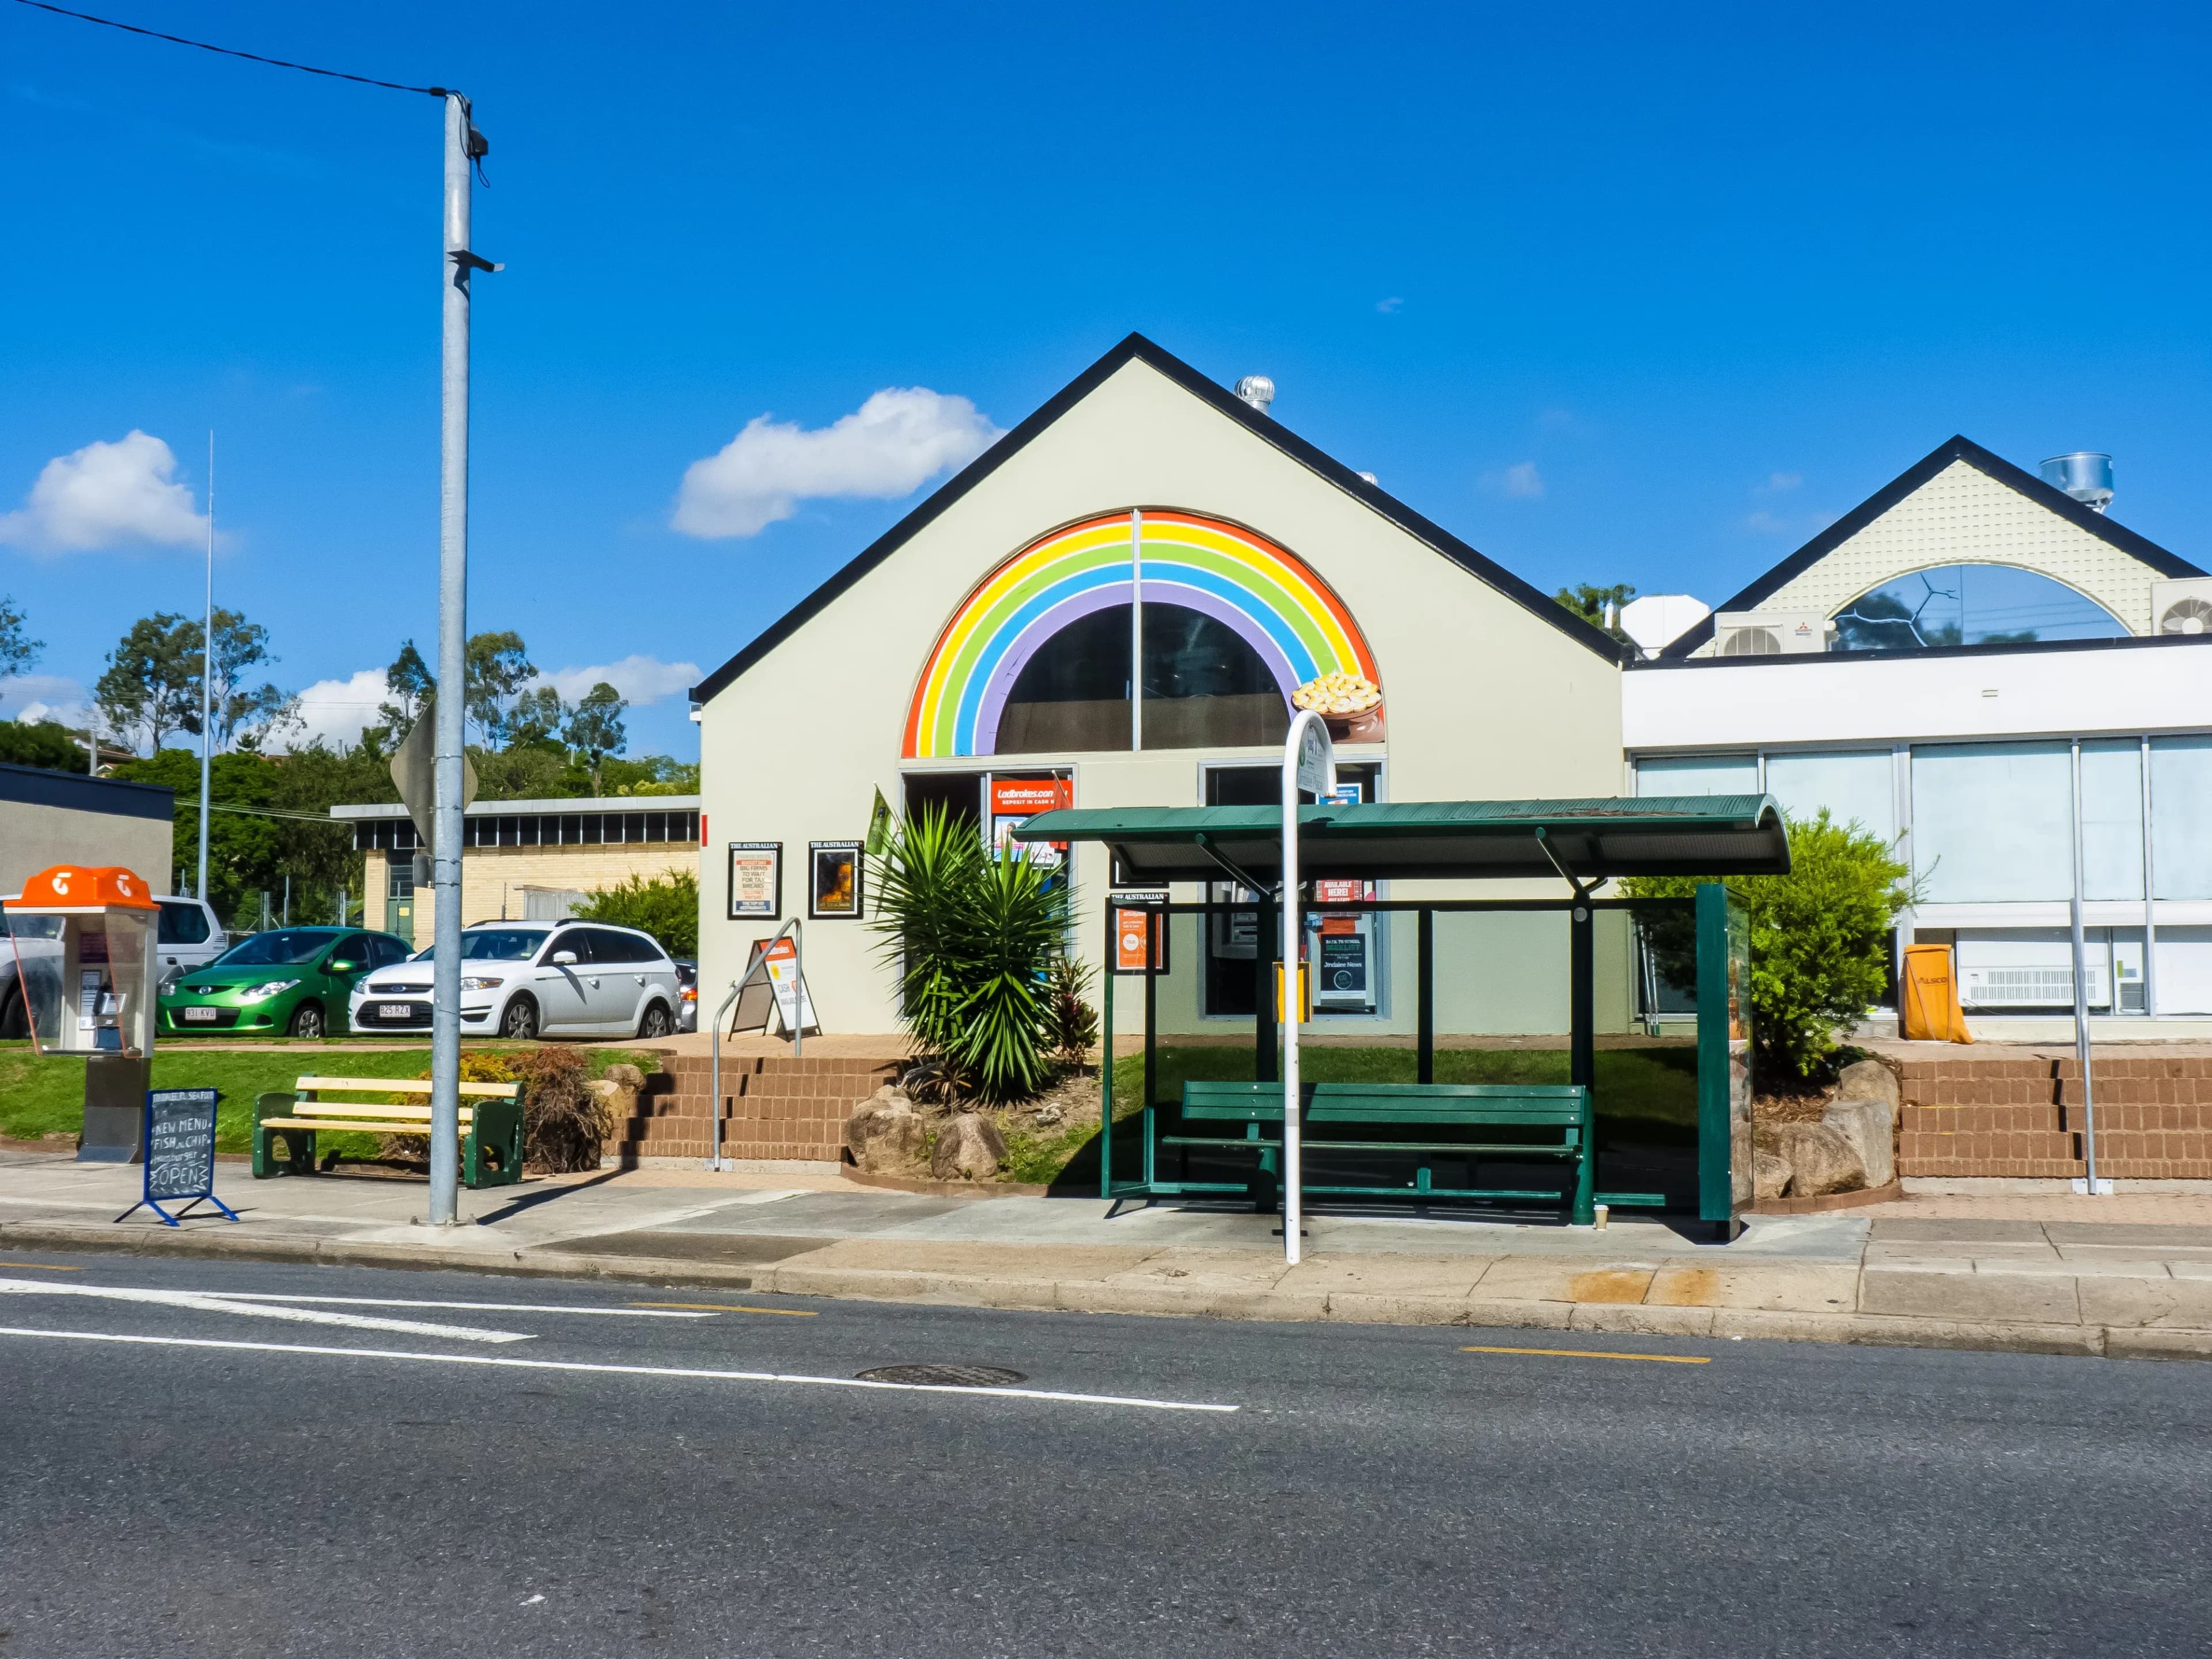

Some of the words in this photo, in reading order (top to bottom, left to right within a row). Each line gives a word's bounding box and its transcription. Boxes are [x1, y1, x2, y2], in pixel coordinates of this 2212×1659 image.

[187, 1009, 198, 1017] 931
[156, 1122, 176, 1135] NEW
[179, 1118, 207, 1132] MENU
[154, 1136, 176, 1150] FISH
[159, 1167, 198, 1185] OPEN
